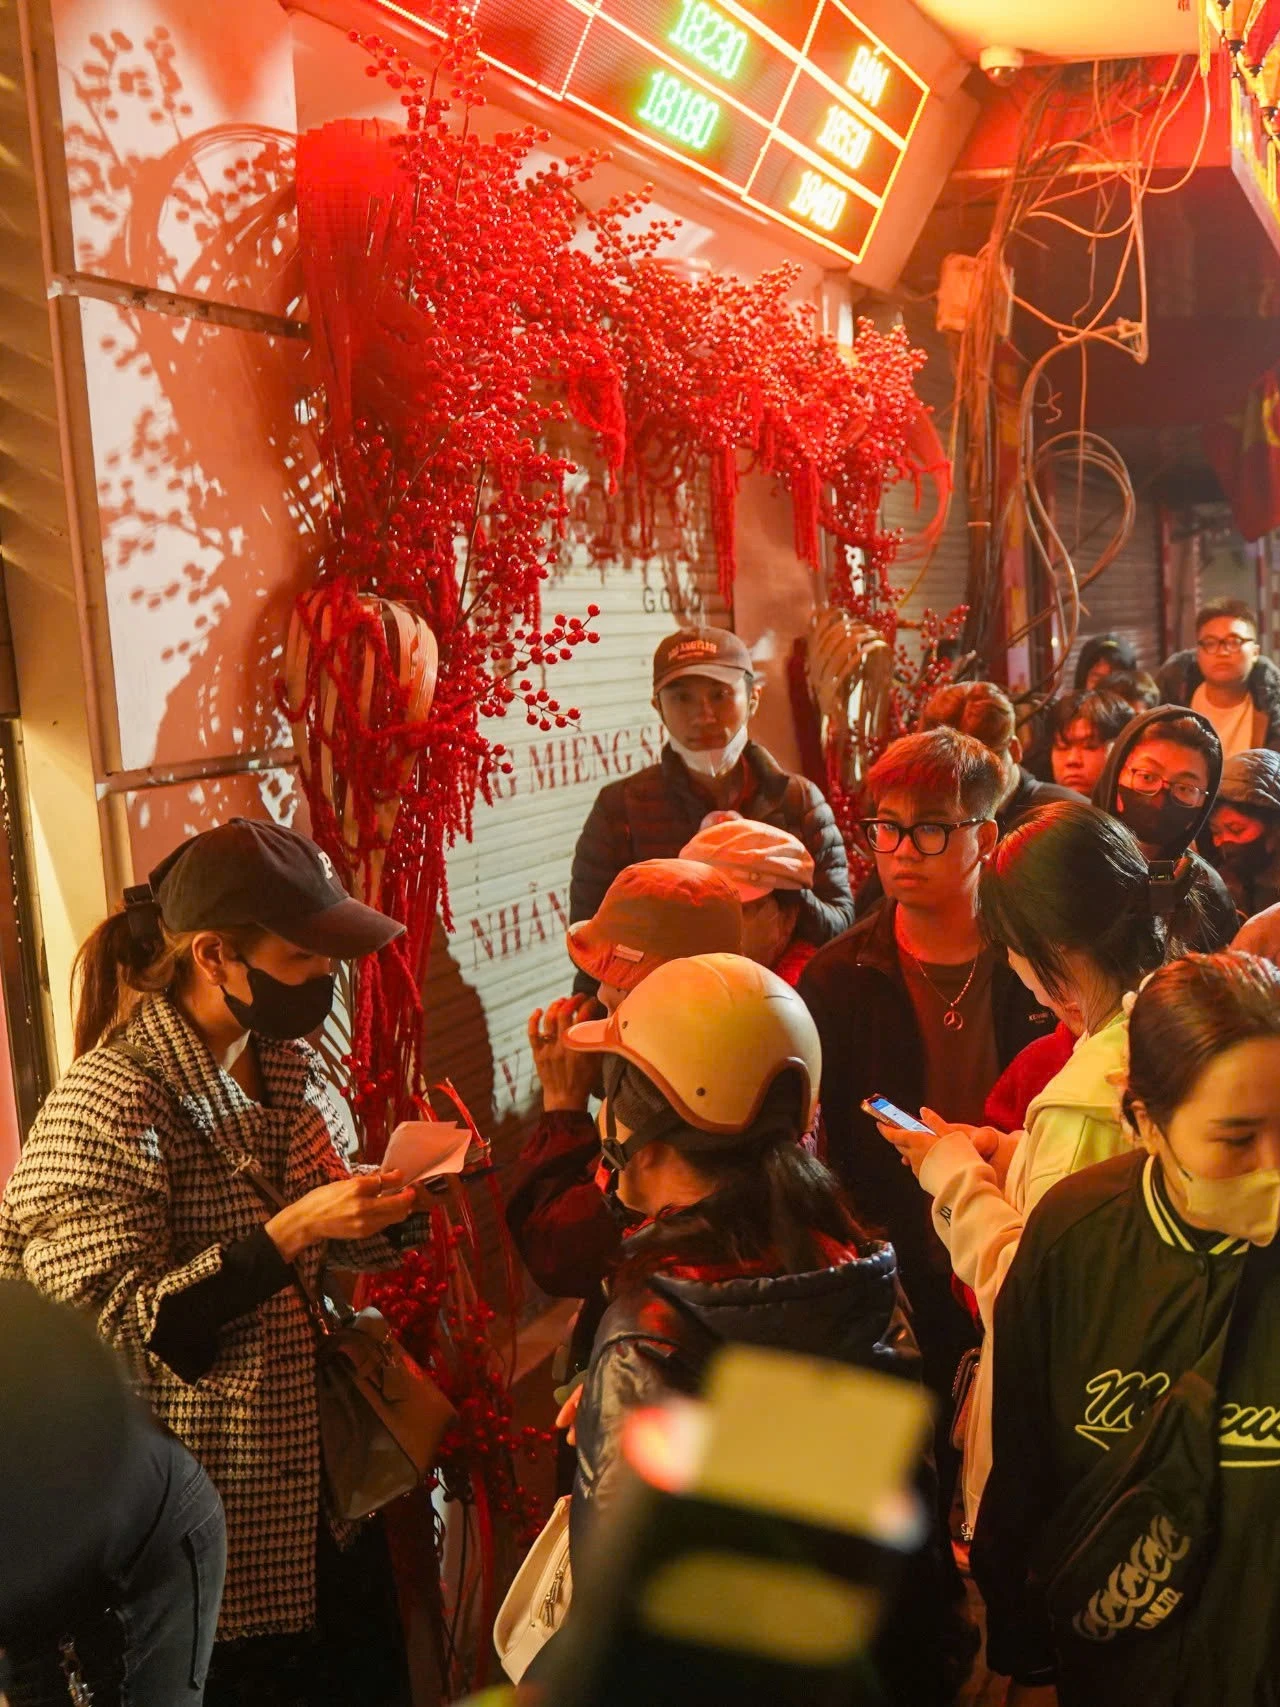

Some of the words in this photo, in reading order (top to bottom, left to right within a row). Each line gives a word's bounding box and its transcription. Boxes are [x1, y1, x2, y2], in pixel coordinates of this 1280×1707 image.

[668, 0, 749, 80] 18230
[637, 70, 721, 150] 18180
[317, 851, 333, 879] P
